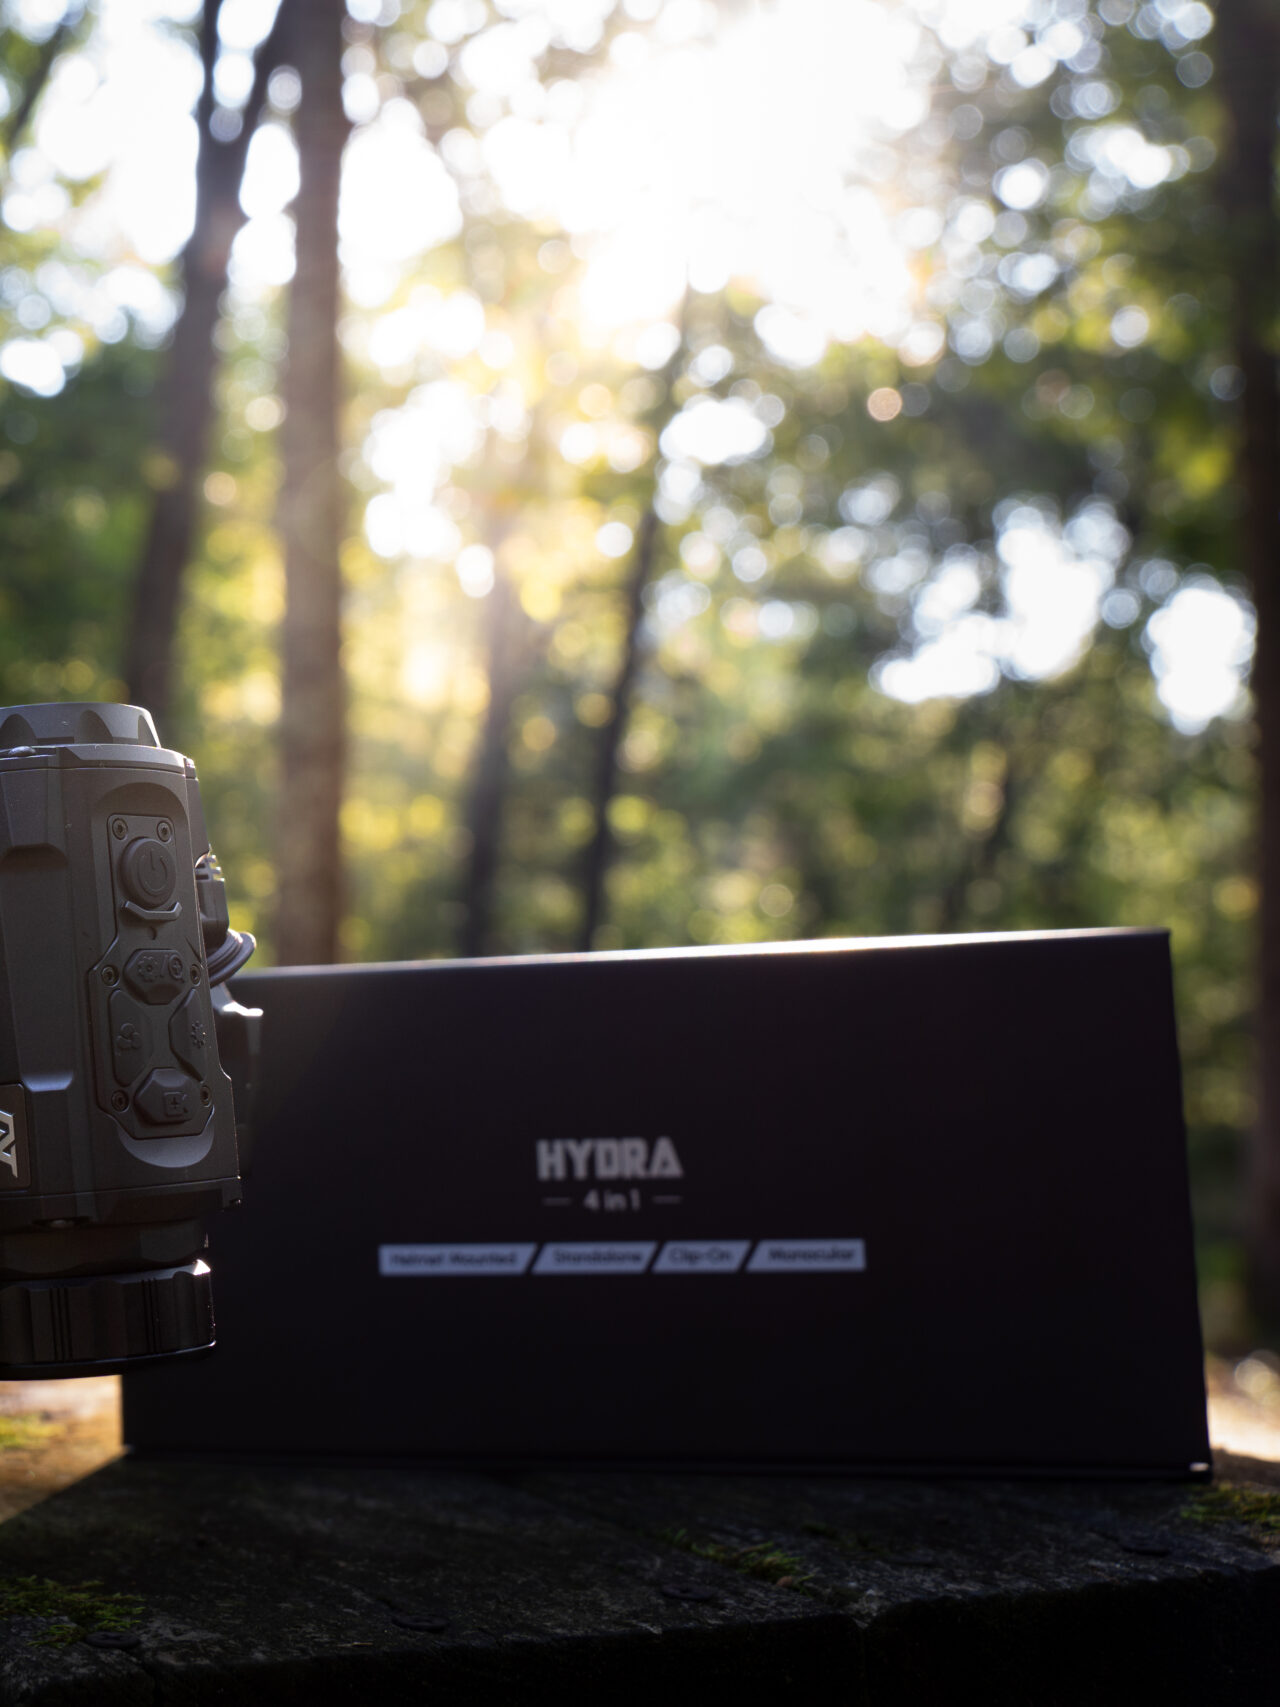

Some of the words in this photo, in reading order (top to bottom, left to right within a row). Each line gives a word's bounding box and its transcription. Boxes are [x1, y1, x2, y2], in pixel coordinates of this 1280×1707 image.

[536, 1136, 683, 1180] HYDRA
[583, 1189, 599, 1211] 4
[603, 1189, 627, 1211] in
